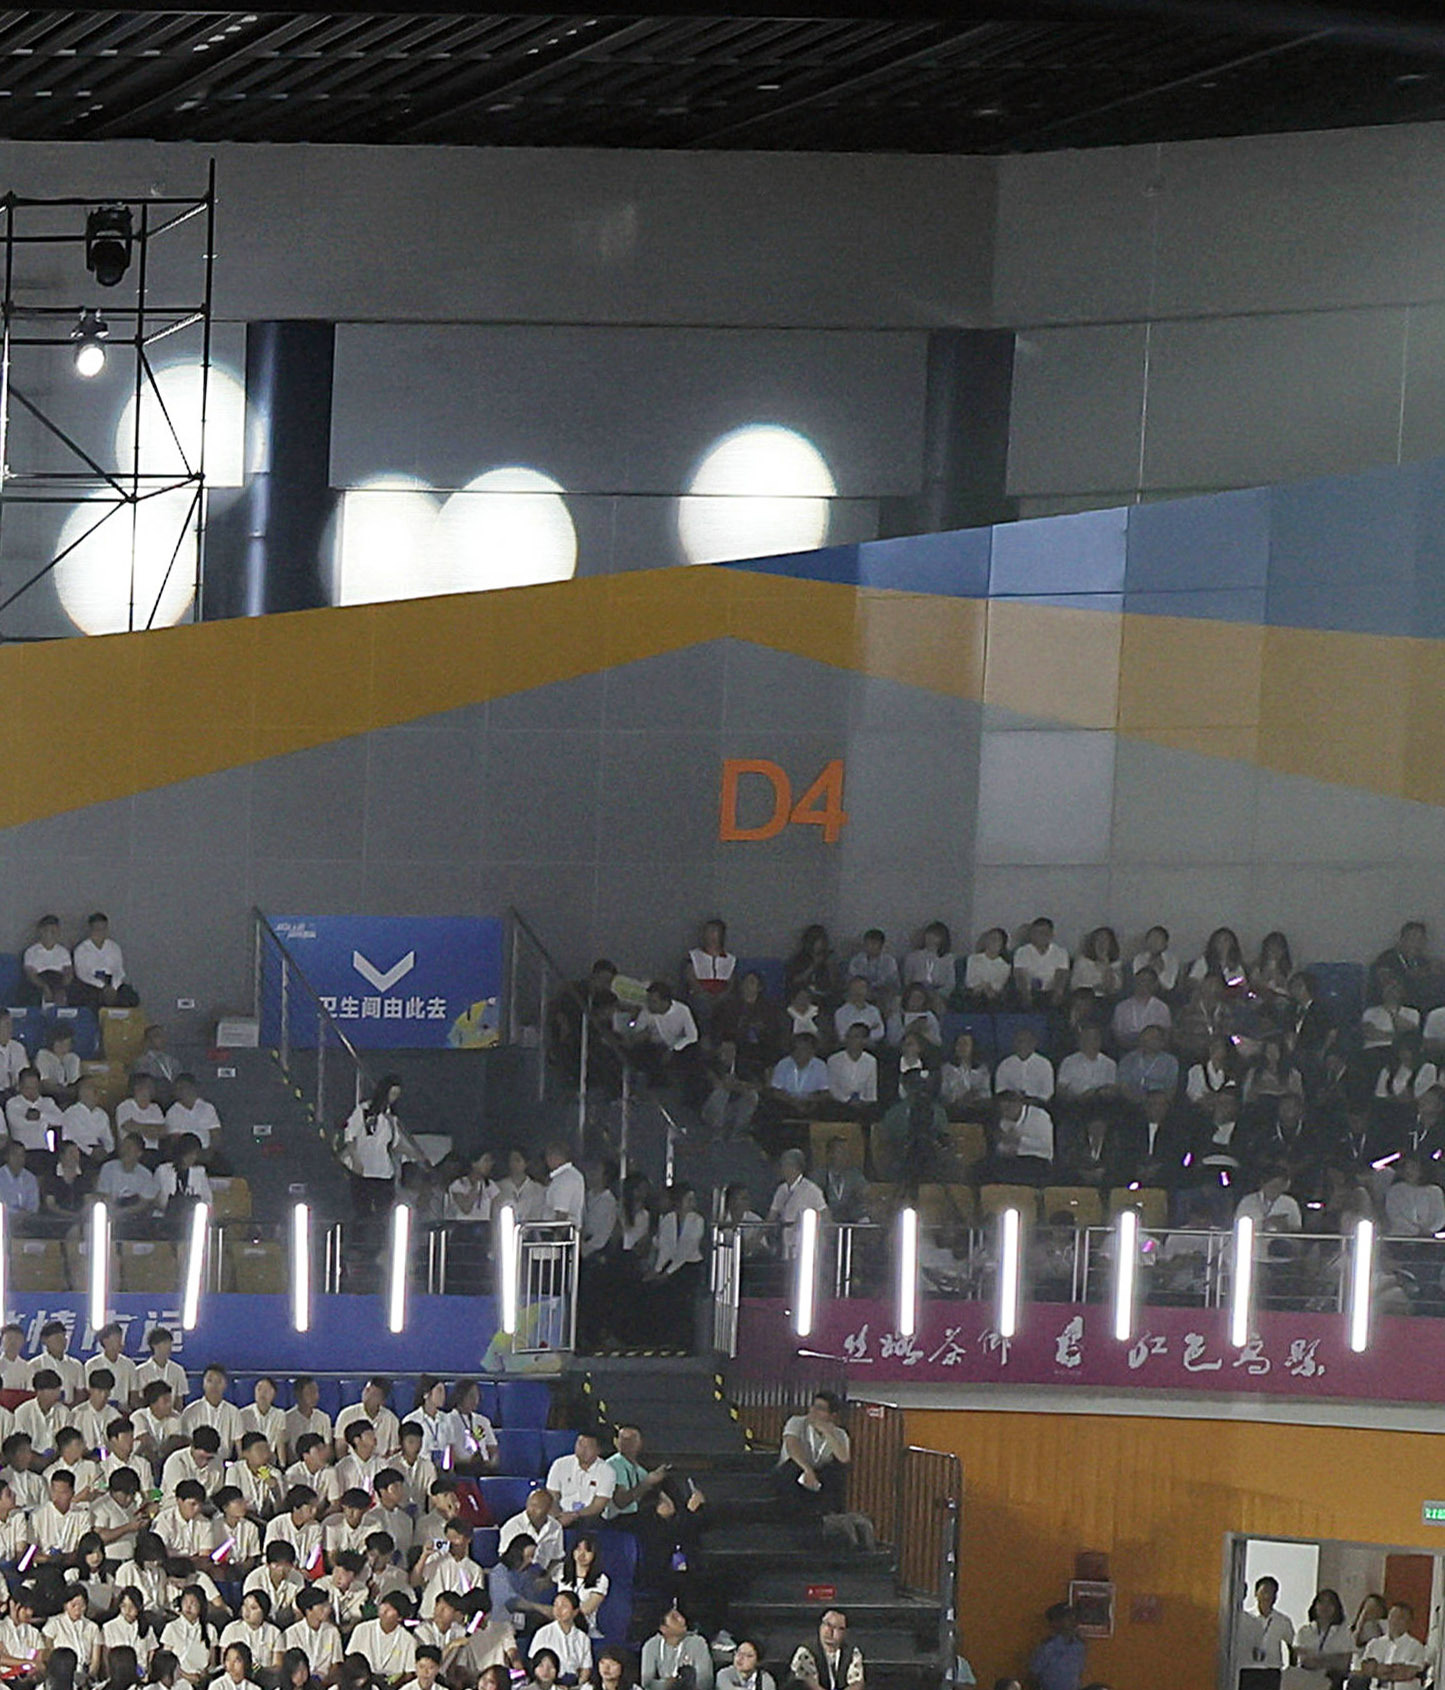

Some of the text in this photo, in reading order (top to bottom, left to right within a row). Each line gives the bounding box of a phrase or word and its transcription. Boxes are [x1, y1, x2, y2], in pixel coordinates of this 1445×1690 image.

[720, 759, 849, 843] D4
[319, 996, 447, 1020] 卫生间由此去
